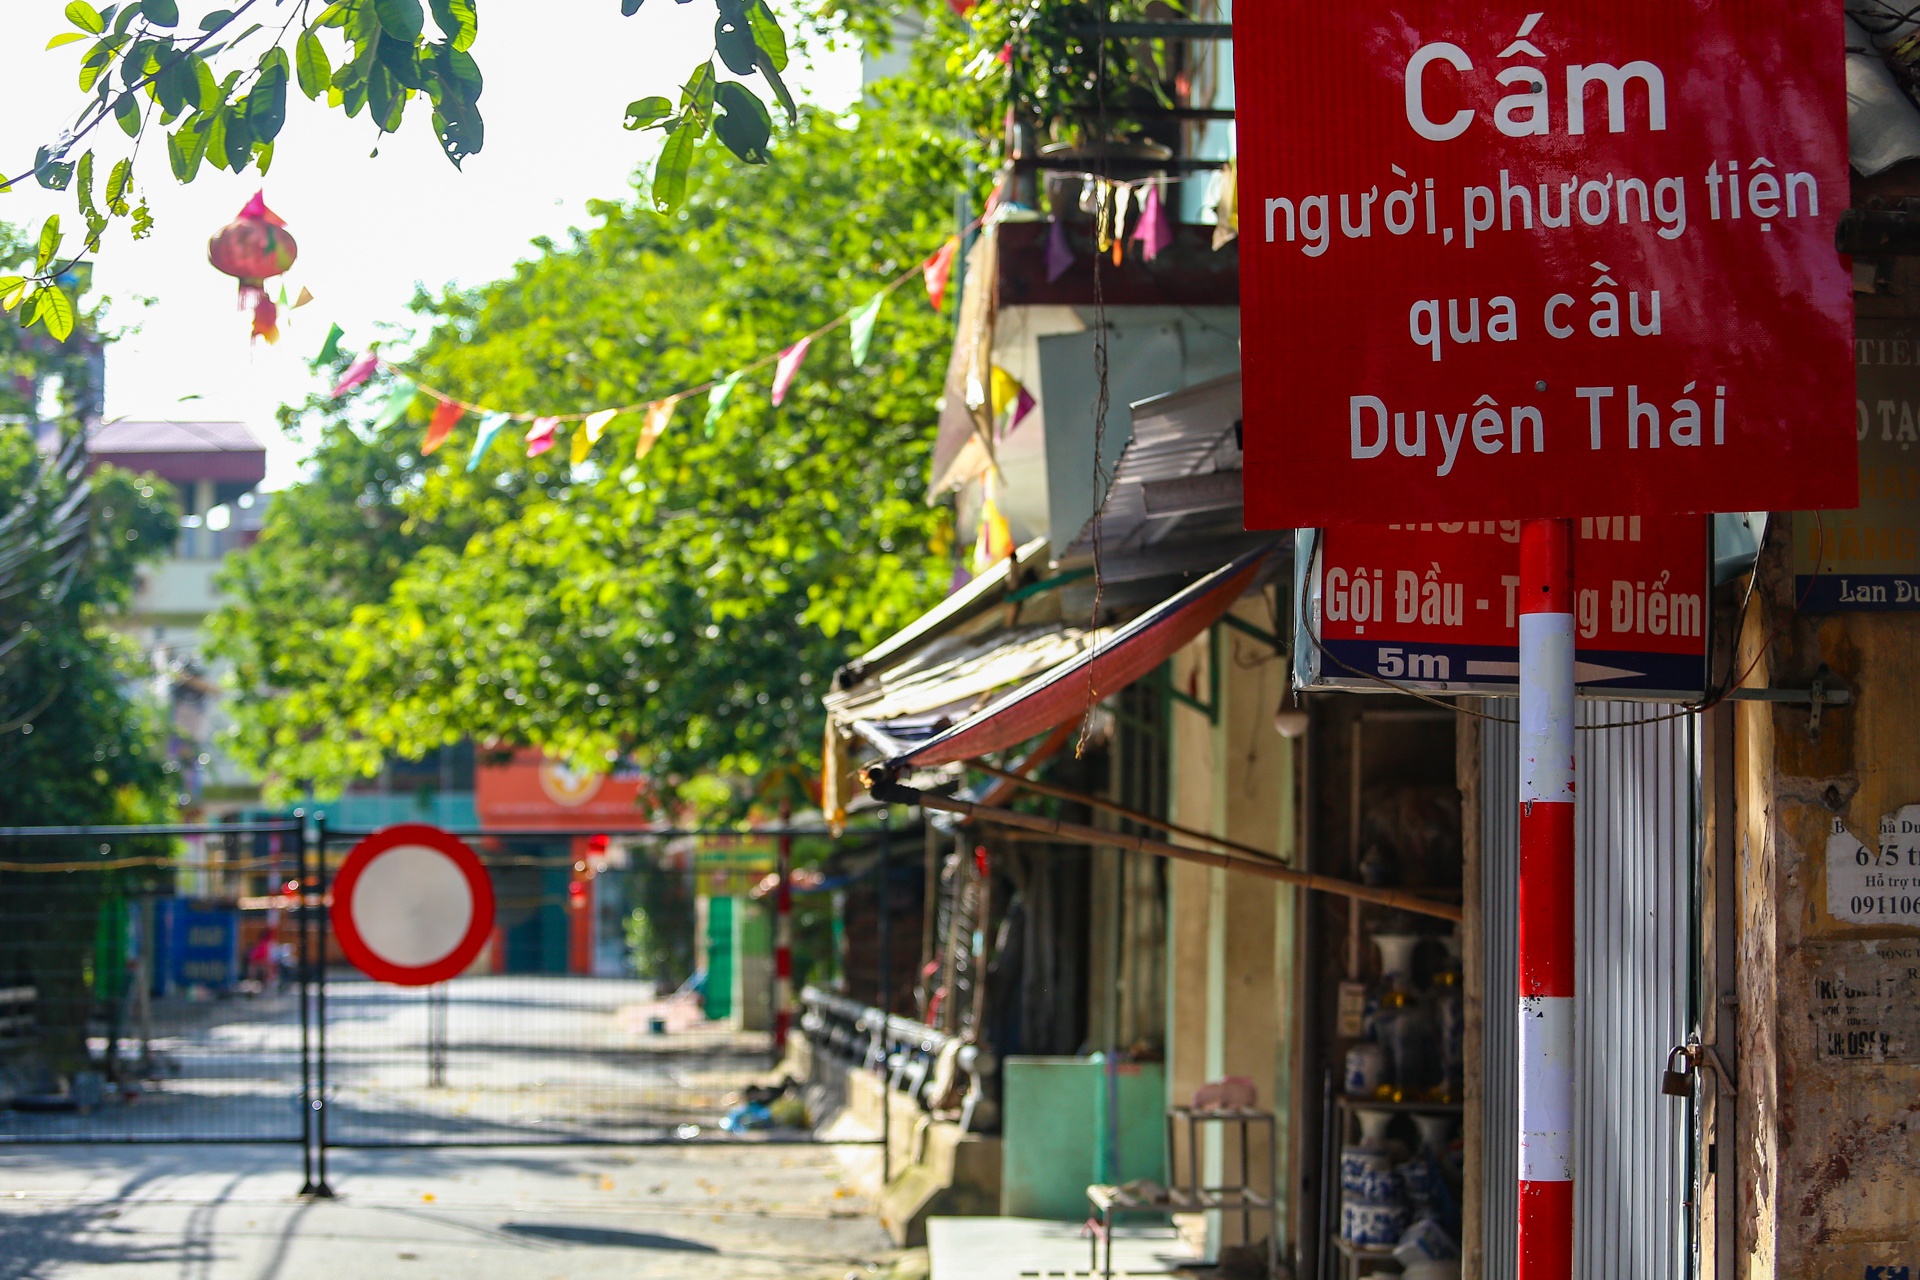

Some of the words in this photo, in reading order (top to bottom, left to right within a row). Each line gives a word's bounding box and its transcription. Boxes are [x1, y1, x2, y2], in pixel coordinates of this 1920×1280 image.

[1404, 12, 1666, 141] Cấm
[1705, 156, 1819, 234] tiện
[1408, 291, 1519, 362] qua
[1543, 260, 1662, 340] cầu
[1855, 328, 1920, 366] TIẾ
[1350, 393, 1544, 477] Duyên
[1575, 379, 1725, 451] Thái
[1325, 567, 1383, 635] Gội
[1395, 561, 1463, 627] Đầu
[1610, 569, 1702, 638] Điểm
[1838, 579, 1888, 603] Lan
[1376, 647, 1451, 680] 5m
[1865, 872, 1885, 888] Hỗ
[1888, 876, 1909, 890] trợ
